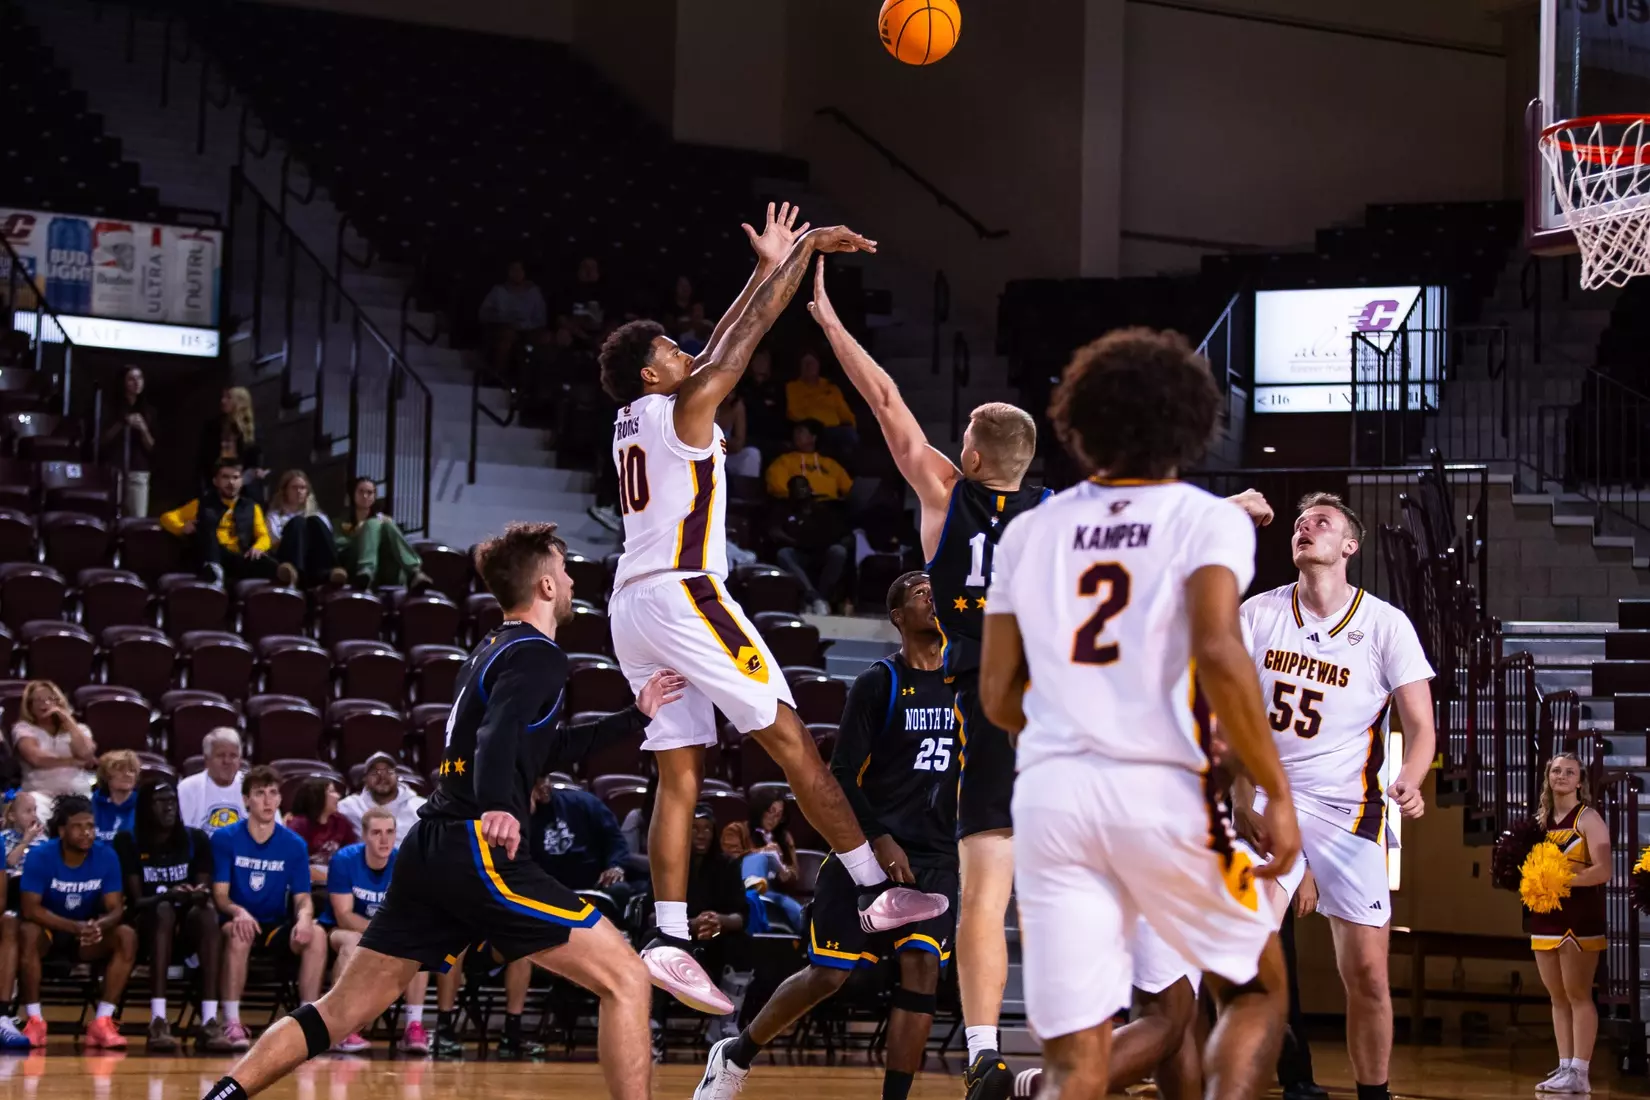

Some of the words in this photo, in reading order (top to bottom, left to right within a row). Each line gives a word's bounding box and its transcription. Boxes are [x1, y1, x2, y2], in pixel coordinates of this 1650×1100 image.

[50, 248, 88, 266] BUD
[147, 254, 163, 313] ULTRA
[616, 416, 639, 441] ROOKS
[618, 443, 650, 516] 10
[1073, 523, 1152, 551] KAMPEN
[964, 531, 997, 587] 1
[1070, 560, 1132, 667] 2
[1263, 649, 1351, 688] CHIPPEWAS
[905, 707, 942, 731] NORTH
[943, 707, 955, 730] PA
[1268, 680, 1325, 740] 55
[913, 737, 953, 772] 25
